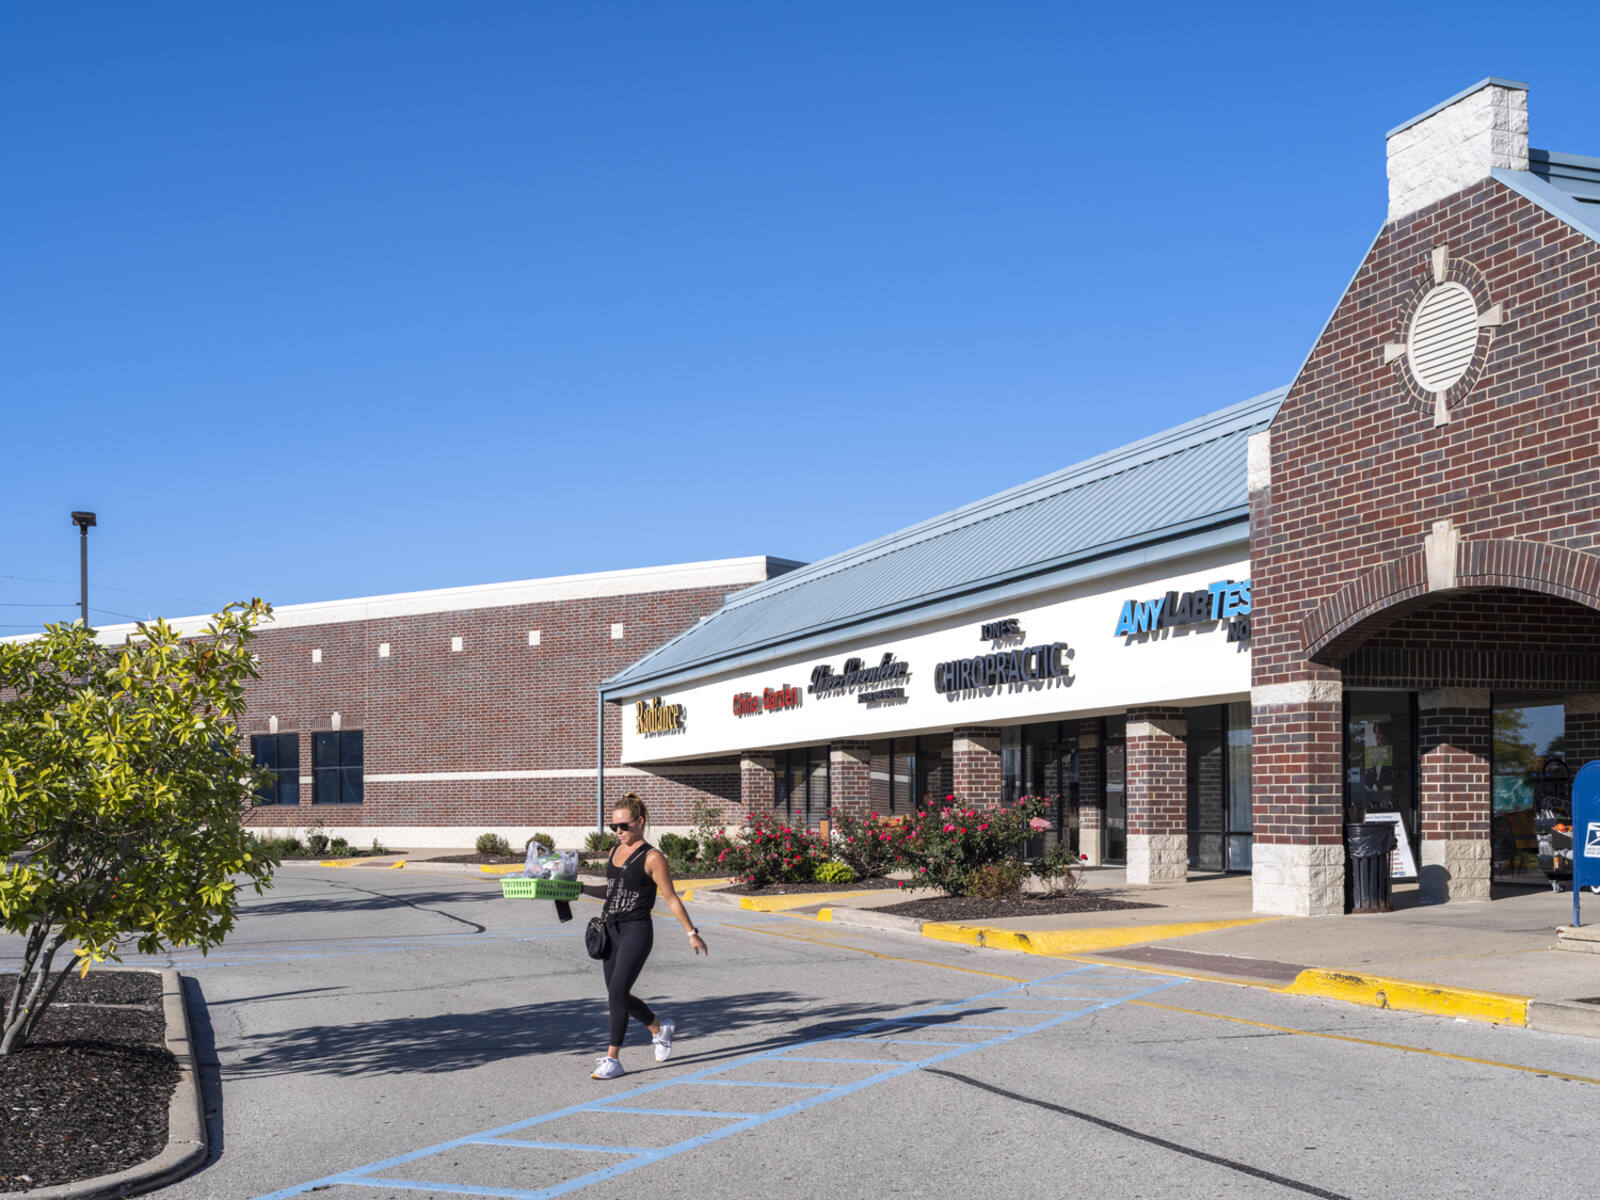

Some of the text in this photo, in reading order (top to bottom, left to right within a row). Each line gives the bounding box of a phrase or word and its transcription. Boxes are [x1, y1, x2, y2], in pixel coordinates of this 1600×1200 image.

[980, 618, 1019, 641] JONES
[1226, 619, 1251, 643] NO
[934, 641, 1067, 694] CHIROPRACTIC
[636, 696, 681, 735] Radiance
[733, 684, 800, 717] China Garden
